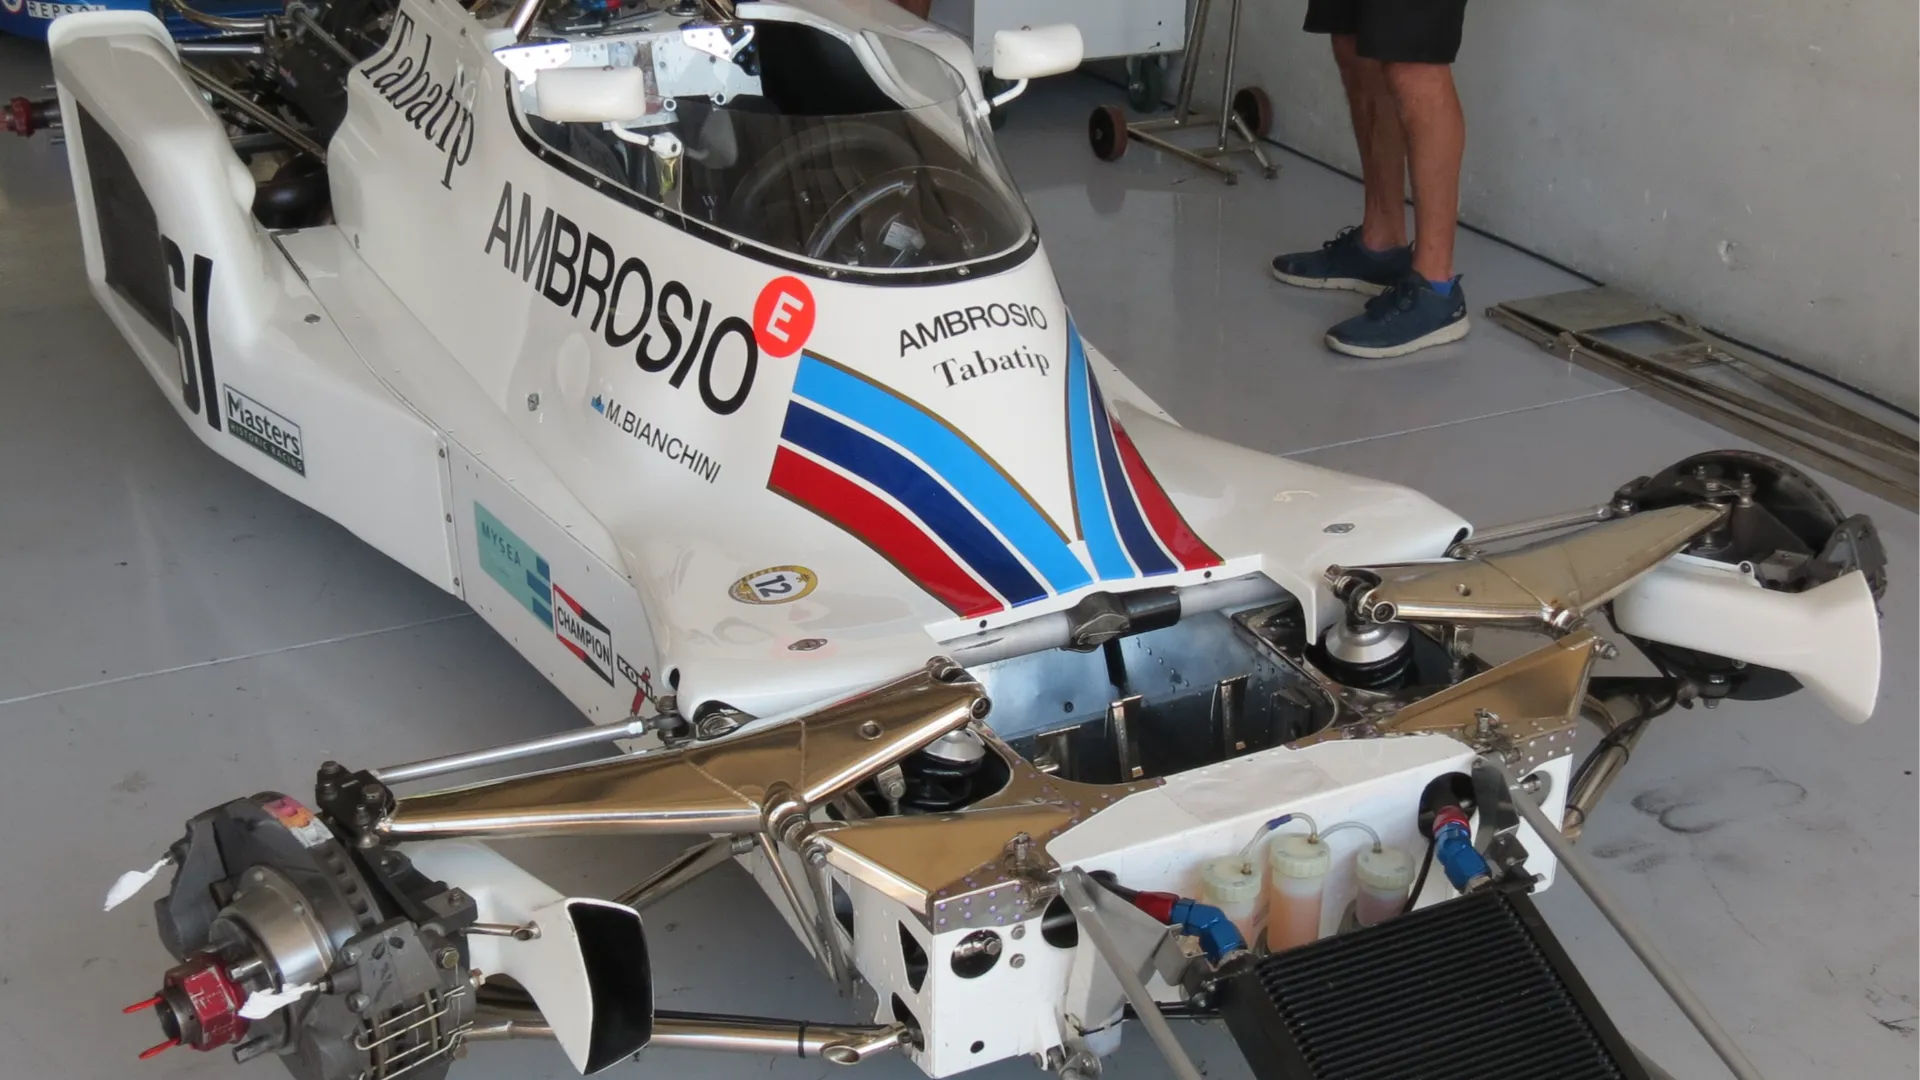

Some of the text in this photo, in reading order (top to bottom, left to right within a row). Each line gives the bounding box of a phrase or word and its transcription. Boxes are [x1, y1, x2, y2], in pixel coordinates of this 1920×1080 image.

[360, 9, 475, 190] Tabatip
[483, 180, 759, 416] AMBROSIO
[765, 291, 804, 343] E
[900, 302, 1048, 359] AMBROSIO
[932, 345, 1051, 389] Tabatip
[226, 390, 301, 456] Masters
[605, 398, 722, 484] M.BIANCHINI
[481, 521, 522, 567] MYSEA
[754, 574, 793, 598] 12
[557, 606, 611, 667] CHAMPION
